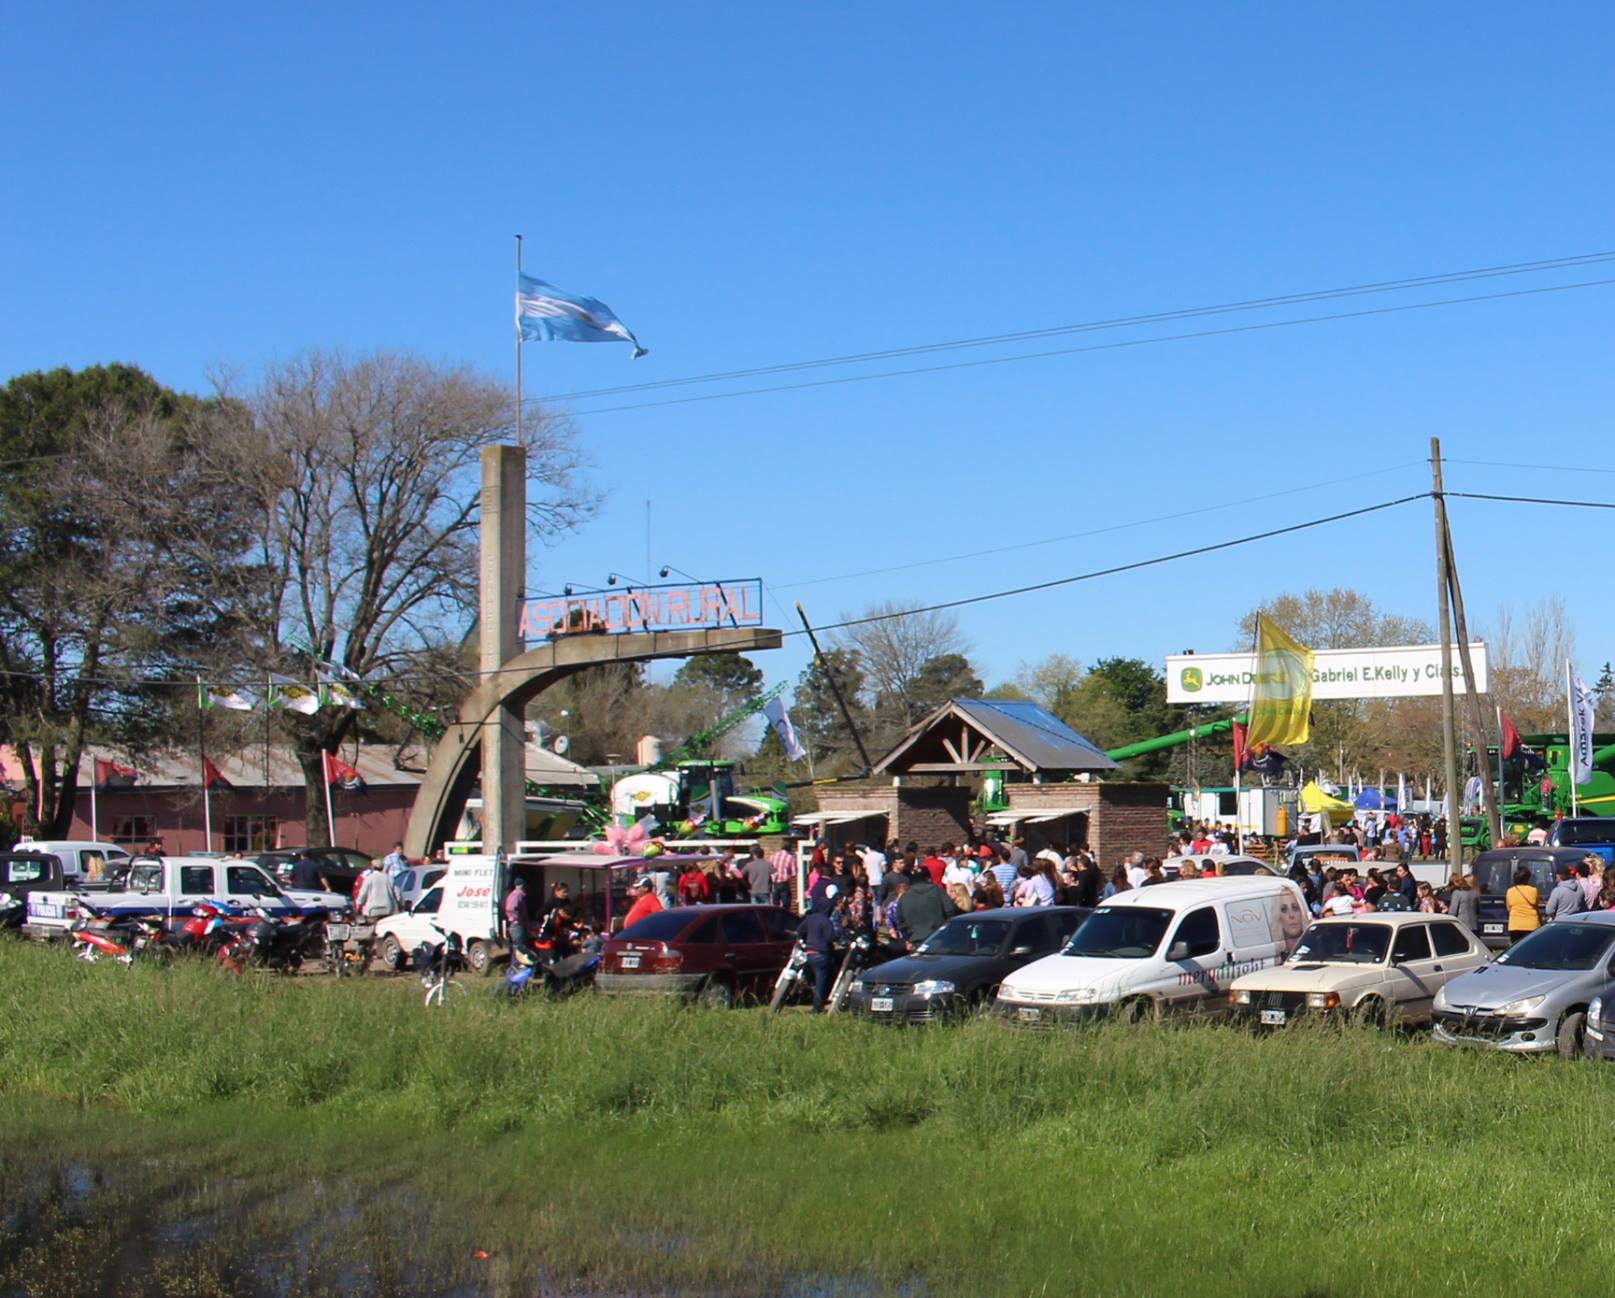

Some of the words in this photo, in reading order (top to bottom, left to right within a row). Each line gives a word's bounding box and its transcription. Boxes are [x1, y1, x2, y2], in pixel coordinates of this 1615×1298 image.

[667, 586, 758, 625] RURAL
[1206, 672, 1240, 686] JOHN
[1311, 666, 1357, 683] Gabriel
[1363, 665, 1408, 683] E.Kelly
[1413, 668, 1420, 683] y
